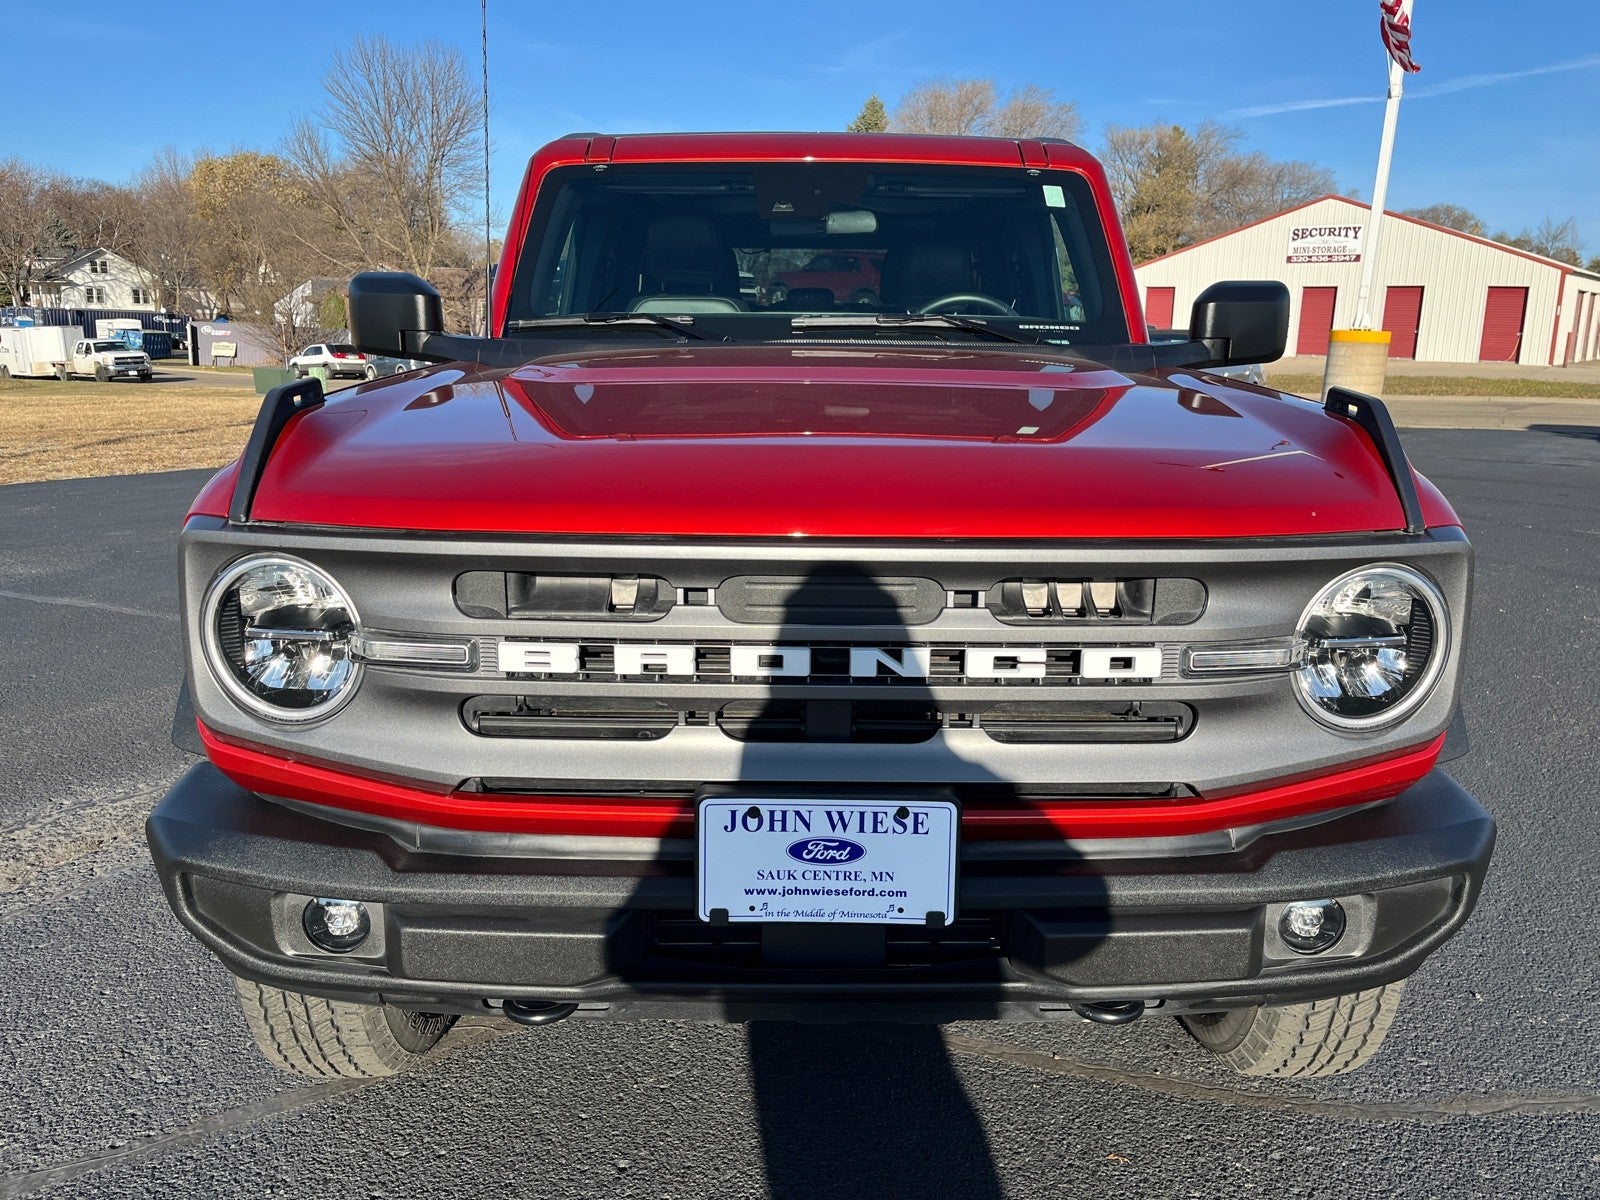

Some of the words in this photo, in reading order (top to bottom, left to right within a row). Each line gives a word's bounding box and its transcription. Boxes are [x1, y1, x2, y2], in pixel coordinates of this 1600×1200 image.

[1291, 226, 1362, 242] SECURITY
[1292, 246, 1348, 254] MINI-STORAGE
[498, 641, 1161, 679] BRONCO
[723, 808, 814, 834] JOHN
[824, 809, 930, 836] WIESE
[802, 840, 851, 861] Ford
[756, 869, 798, 881] SAUK
[801, 870, 867, 884] CENTRE,
[870, 871, 895, 882] MN
[744, 886, 907, 898] www.johnwieseford.com
[764, 909, 775, 918] in
[777, 908, 791, 918] the
[793, 908, 826, 919] Middle
[827, 909, 837, 921] of
[838, 909, 888, 920] Minnesota
